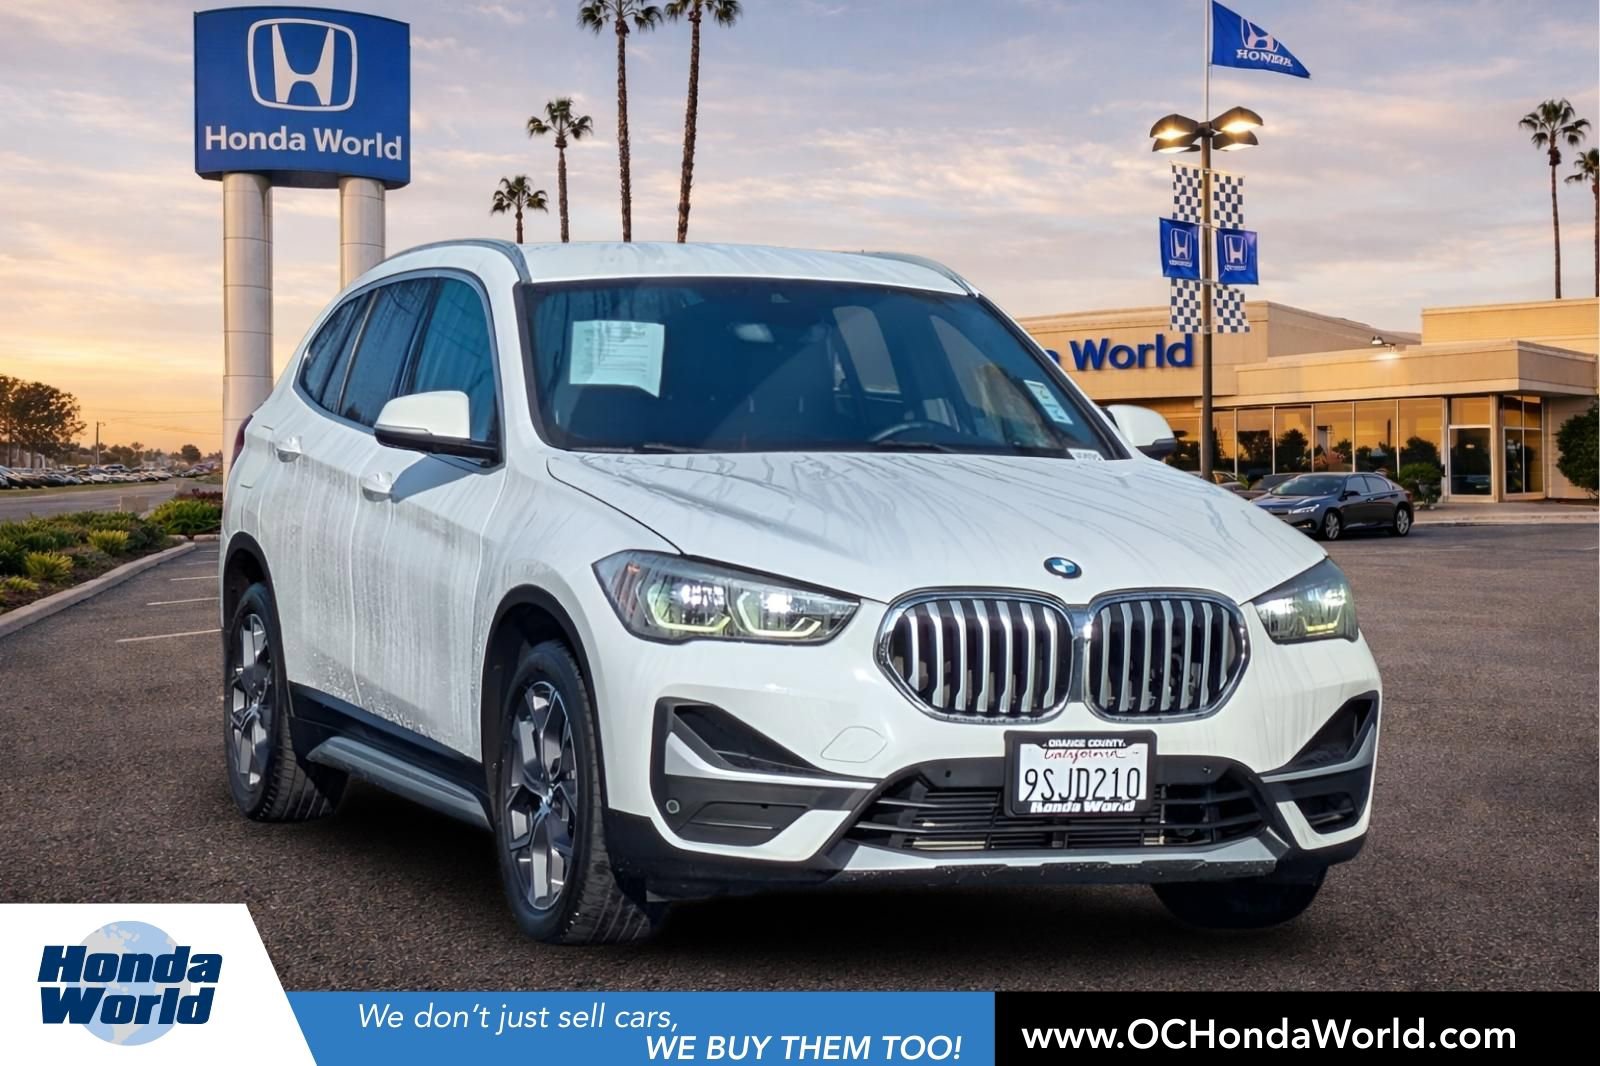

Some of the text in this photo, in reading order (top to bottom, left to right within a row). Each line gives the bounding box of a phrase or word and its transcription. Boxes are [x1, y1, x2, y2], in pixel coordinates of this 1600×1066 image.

[205, 125, 402, 160] Honda World
[1070, 333, 1194, 371] World
[1048, 738, 1124, 748] ORANGE COUNTY
[1024, 767, 1141, 802] 9SJD210
[1030, 800, 1136, 813] Honda World
